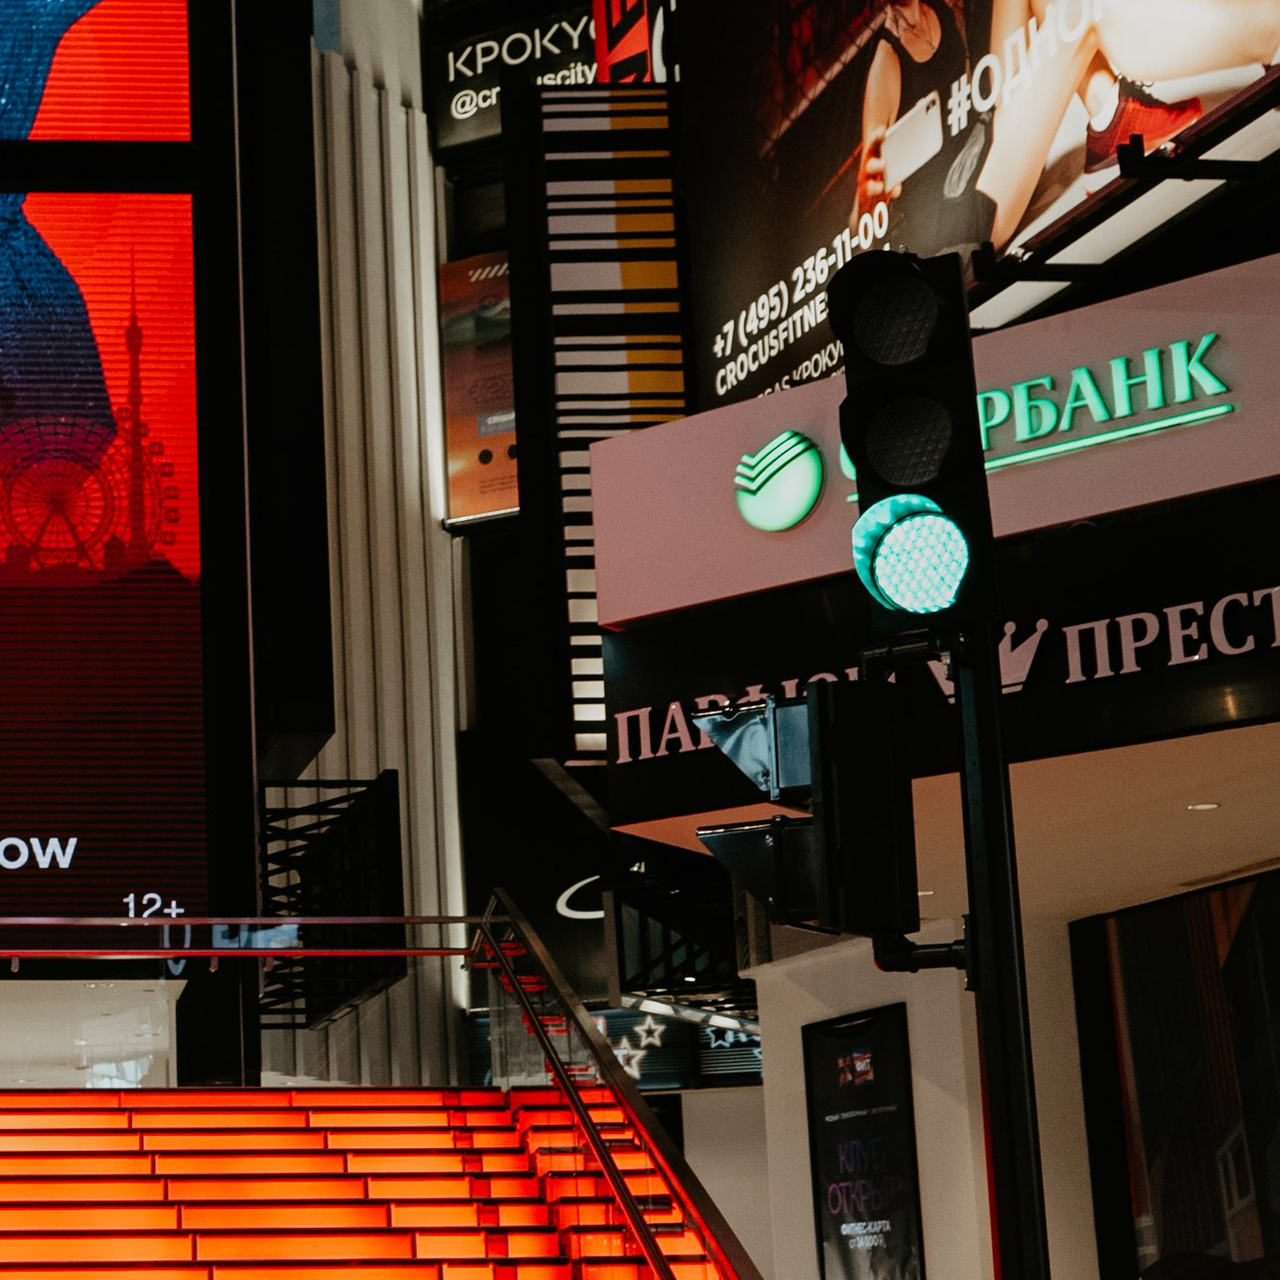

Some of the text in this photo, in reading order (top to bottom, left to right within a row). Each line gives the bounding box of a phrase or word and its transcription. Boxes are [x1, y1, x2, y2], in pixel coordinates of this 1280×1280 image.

[712, 200, 889, 359] +7 (495) 236-11-00
[122, 892, 186, 924] 12+
